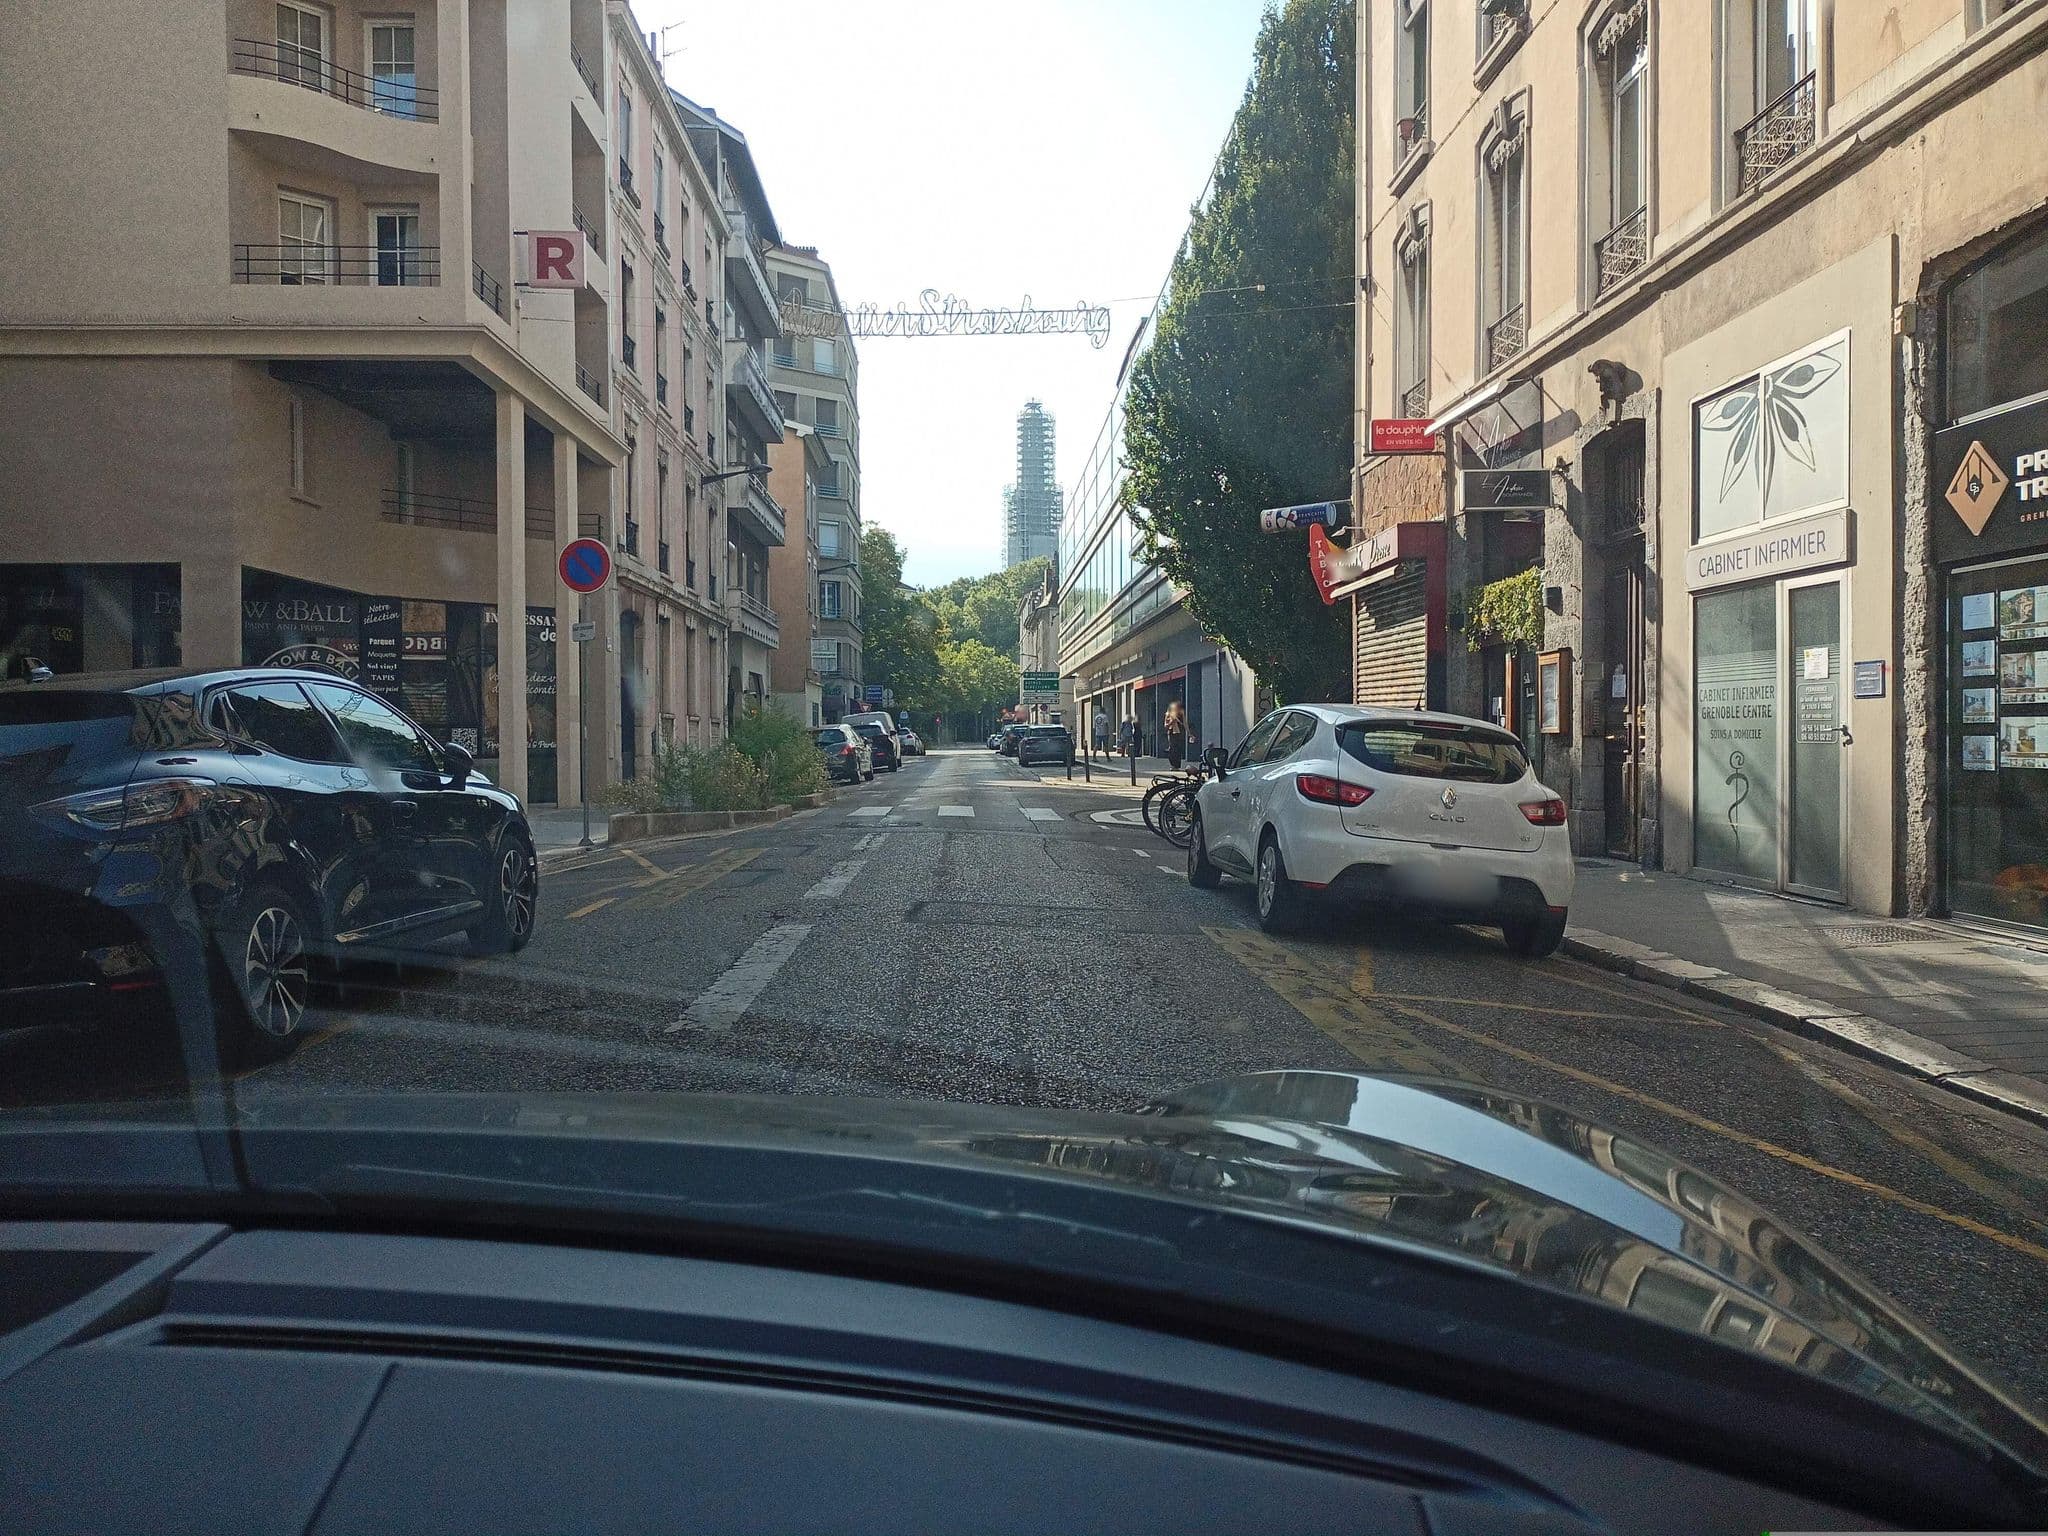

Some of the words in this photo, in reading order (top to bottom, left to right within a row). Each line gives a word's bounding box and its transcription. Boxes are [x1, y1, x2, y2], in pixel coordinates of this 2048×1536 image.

[536, 237, 575, 279] R
[918, 288, 1110, 350] Strasbourg
[1375, 425, 1384, 435] le
[1386, 424, 1426, 436] dauphin
[1699, 548, 1752, 578] CABINET
[1755, 530, 1826, 567] INFIRMIER
[368, 604, 391, 613] Notre
[369, 638, 395, 646] Parquet
[380, 663, 397, 671] vinyl
[1699, 688, 1730, 702] CABINET
[1732, 685, 1775, 701] INFIRMIER
[1701, 705, 1740, 719] GRENOBLE
[1742, 704, 1772, 718] CENTRE
[1710, 729, 1727, 739] SOINS
[1428, 812, 1468, 824] CLIO
